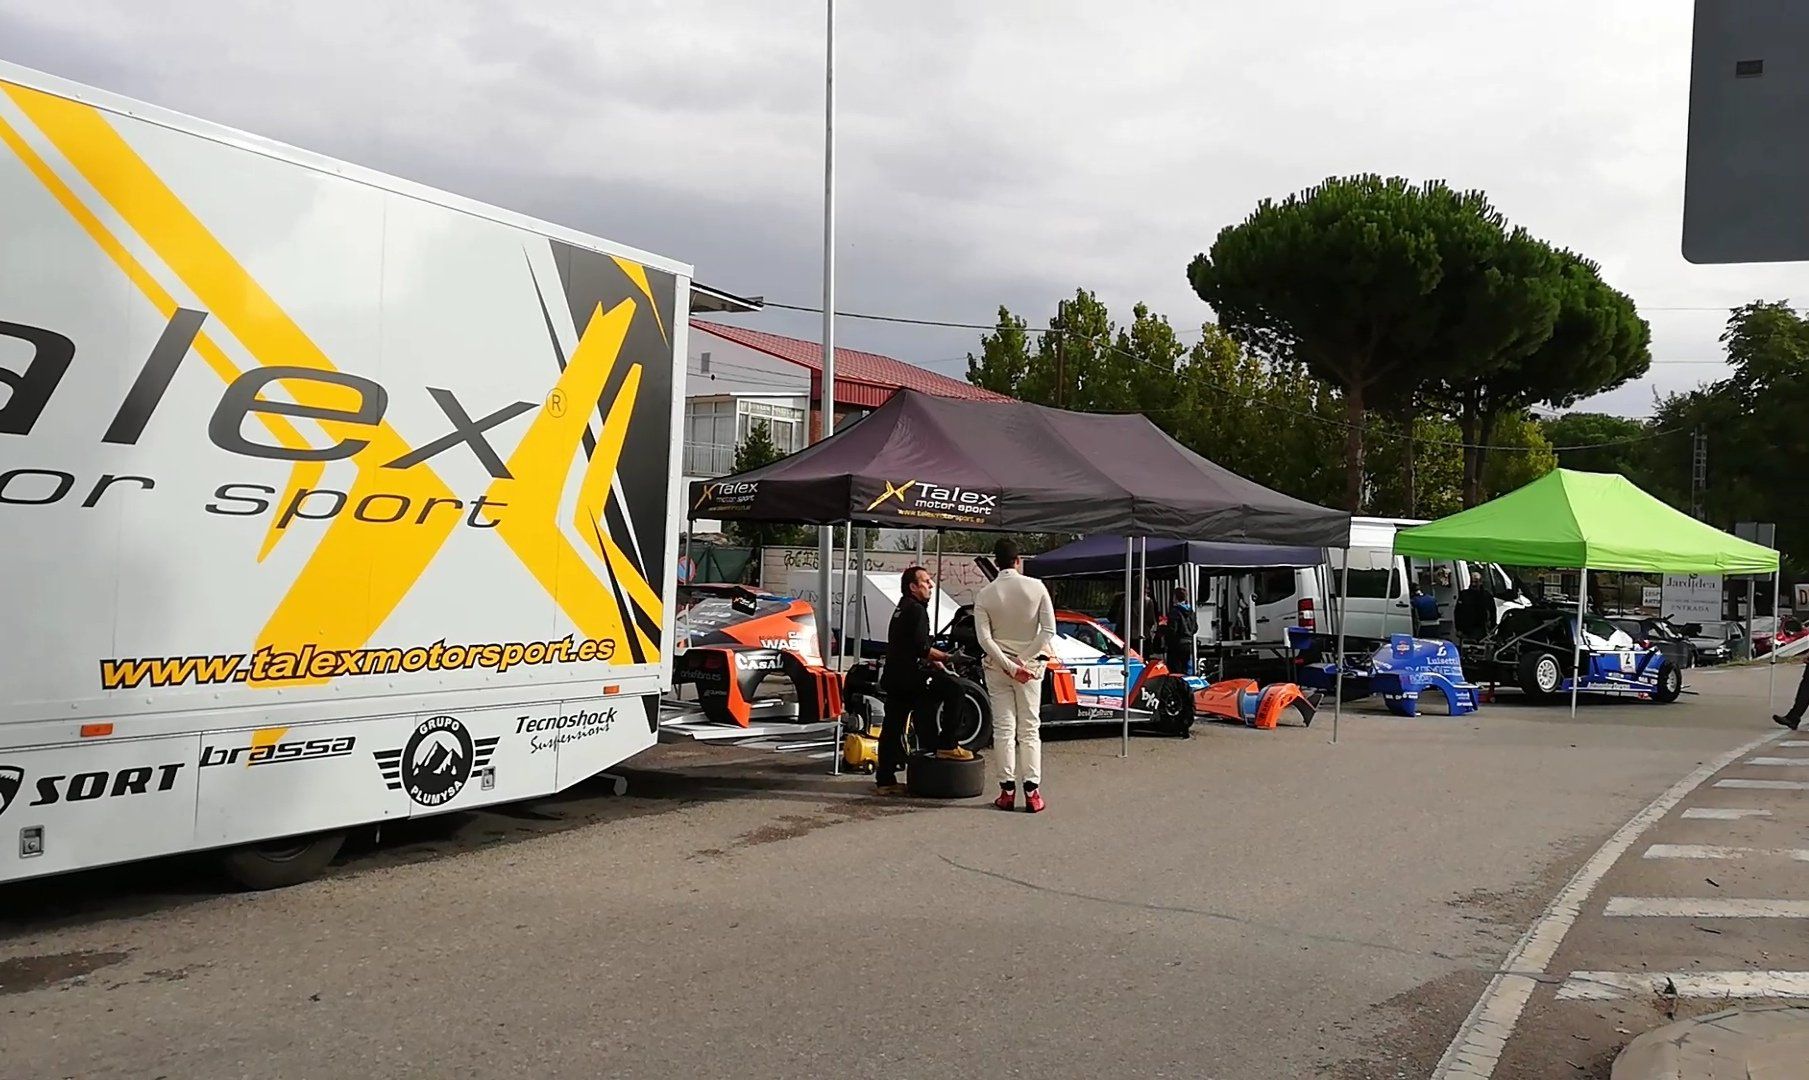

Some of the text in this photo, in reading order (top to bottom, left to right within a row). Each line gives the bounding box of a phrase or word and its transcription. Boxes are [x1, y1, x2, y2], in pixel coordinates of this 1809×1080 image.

[718, 482, 759, 494] Talex
[915, 482, 997, 507] Talex
[205, 483, 508, 529] sport
[915, 499, 992, 515] motor sport
[100, 634, 616, 690] www.talexmotorsport.es
[1082, 668, 1092, 688] 4
[419, 717, 460, 735] GRUPO
[515, 707, 618, 734] Tecnoshock
[199, 736, 356, 768] brassa
[29, 763, 185, 806] SORT
[410, 780, 463, 804] PLUMYSA
